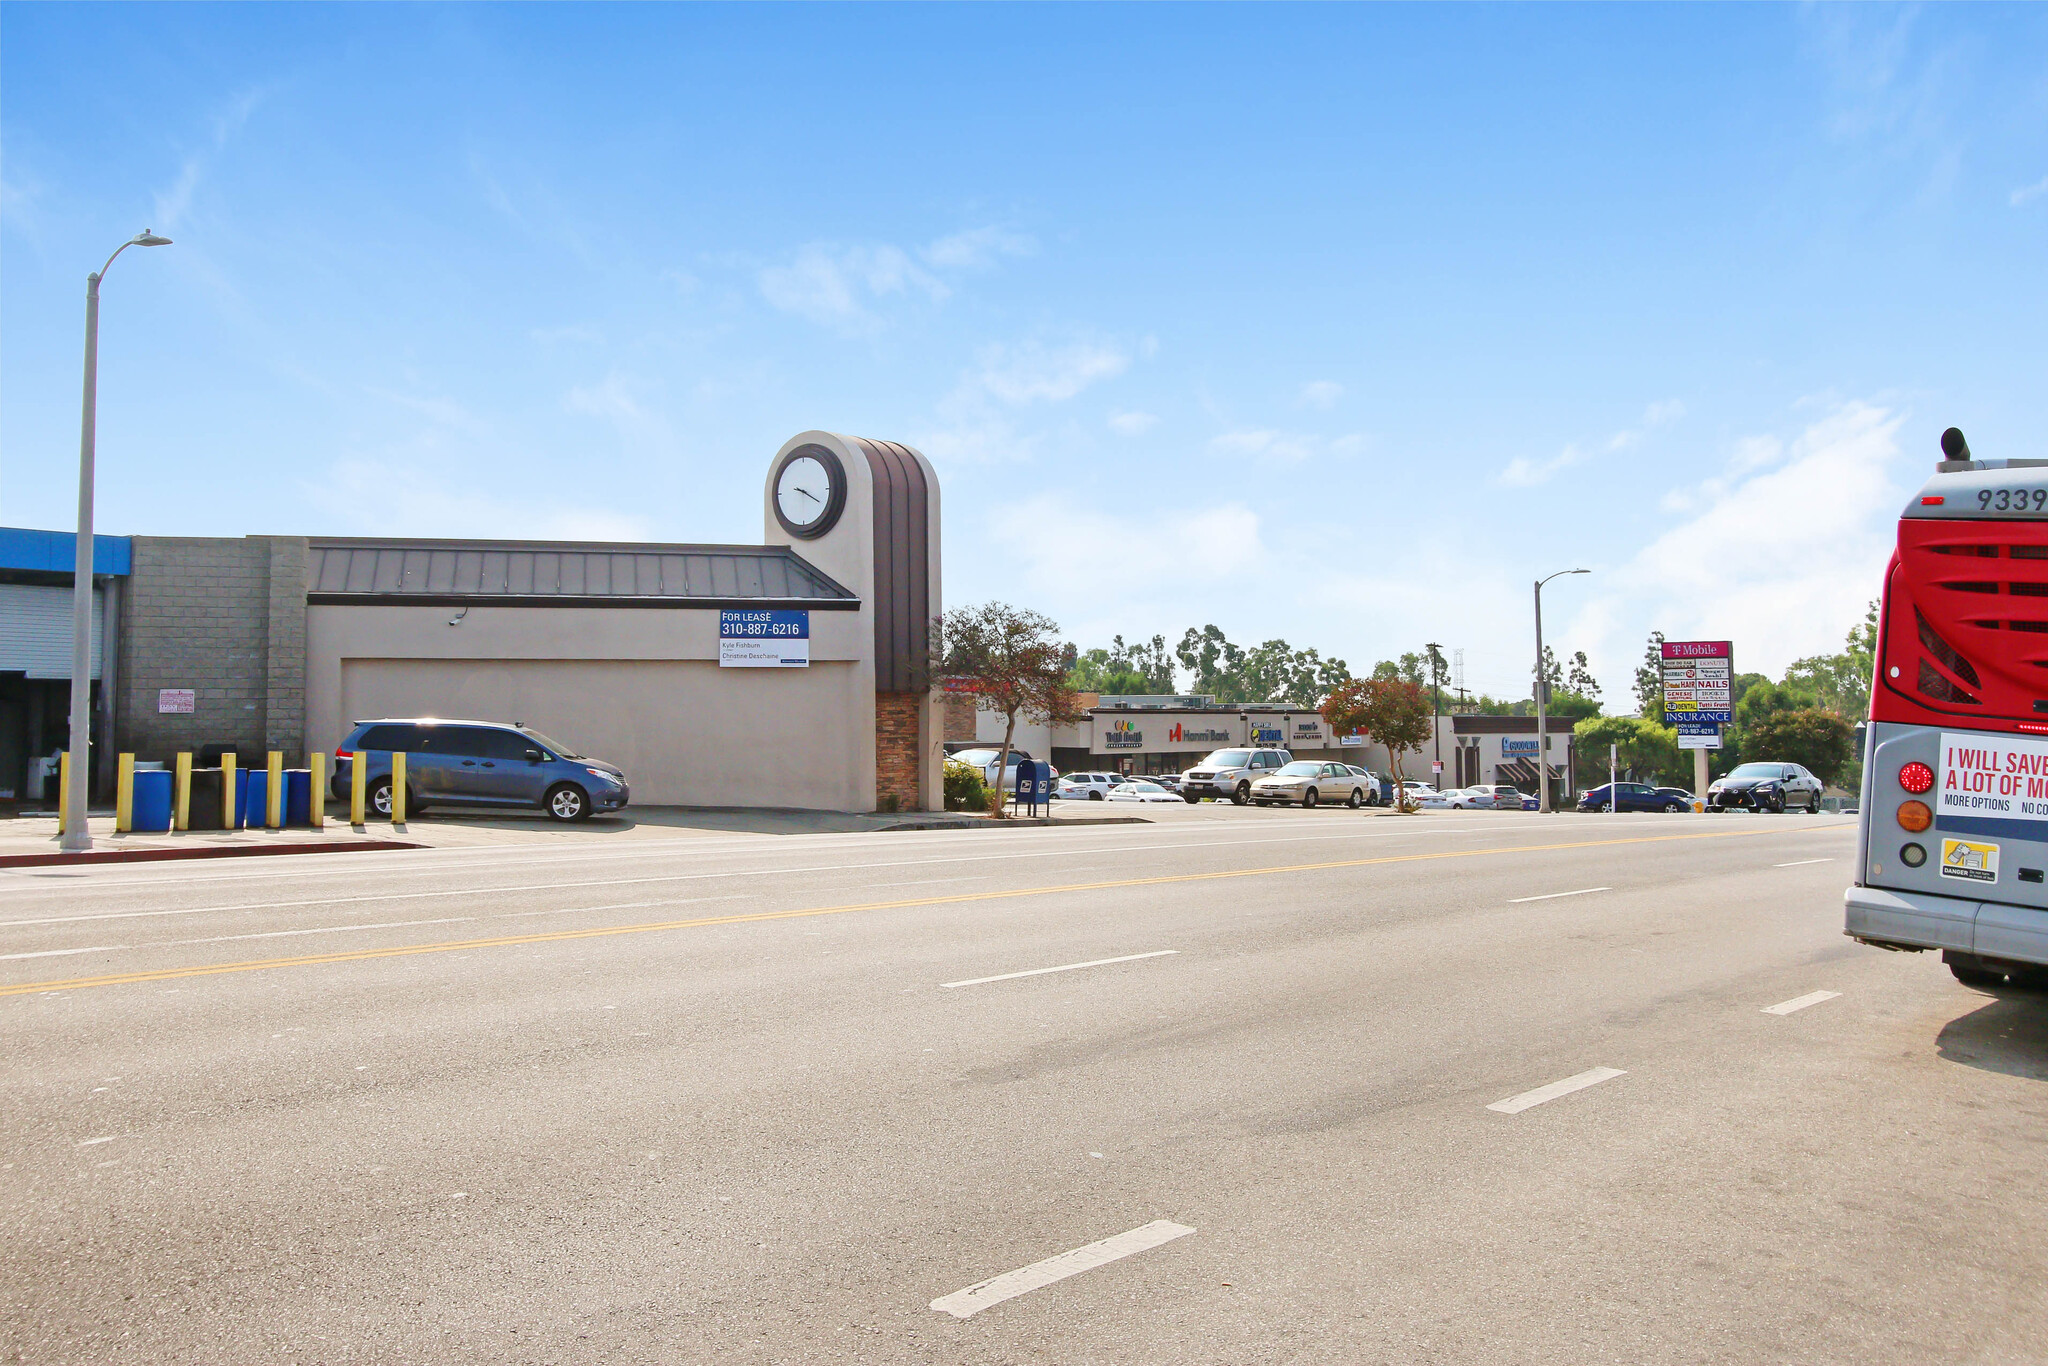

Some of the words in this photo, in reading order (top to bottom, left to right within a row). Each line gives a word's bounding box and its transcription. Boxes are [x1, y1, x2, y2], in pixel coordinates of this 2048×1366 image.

[1977, 489, 2048, 511] 9339
[722, 612, 740, 621] FOR
[742, 612, 771, 622] LEASE
[722, 623, 799, 634] 310-887-6216
[1683, 644, 1717, 655] Mobile
[1666, 712, 1729, 721] INSURANCE
[1184, 730, 1208, 741] Hanmi
[1210, 730, 1229, 741] Bank
[1948, 748, 1953, 767] I
[1958, 748, 2001, 772] WILL
[2006, 752, 2048, 776] SAVE
[1946, 770, 1957, 790] A
[1963, 771, 1995, 793] LOT
[2000, 774, 2022, 796] OF
[1944, 794, 1970, 808] MORE
[1972, 796, 2010, 812] OPTIONS
[2022, 802, 2034, 814] NO
[1944, 868, 1968, 876] DANGER
